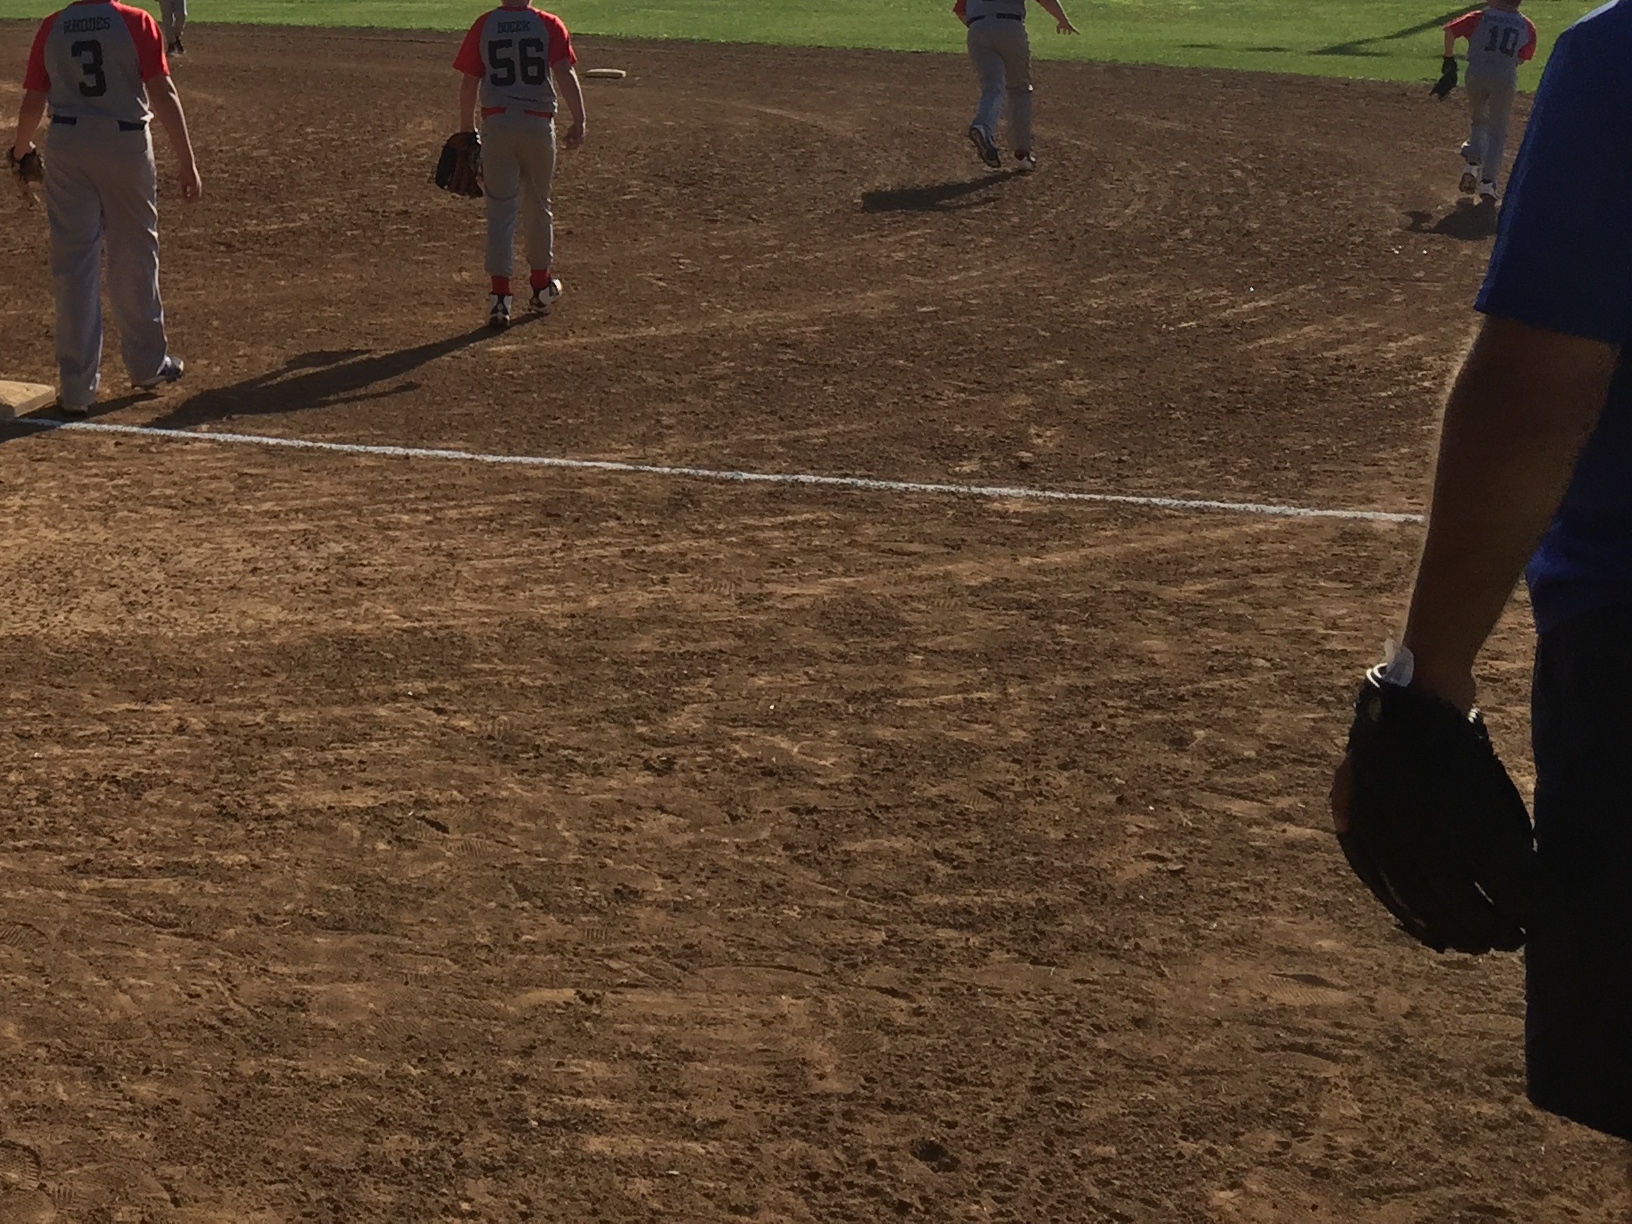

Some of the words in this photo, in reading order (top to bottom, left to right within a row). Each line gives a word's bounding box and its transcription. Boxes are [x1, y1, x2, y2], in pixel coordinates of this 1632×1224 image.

[63, 16, 111, 35] RHODES
[1483, 24, 1520, 58] 10
[71, 39, 107, 98] 3
[488, 37, 546, 87] 56
